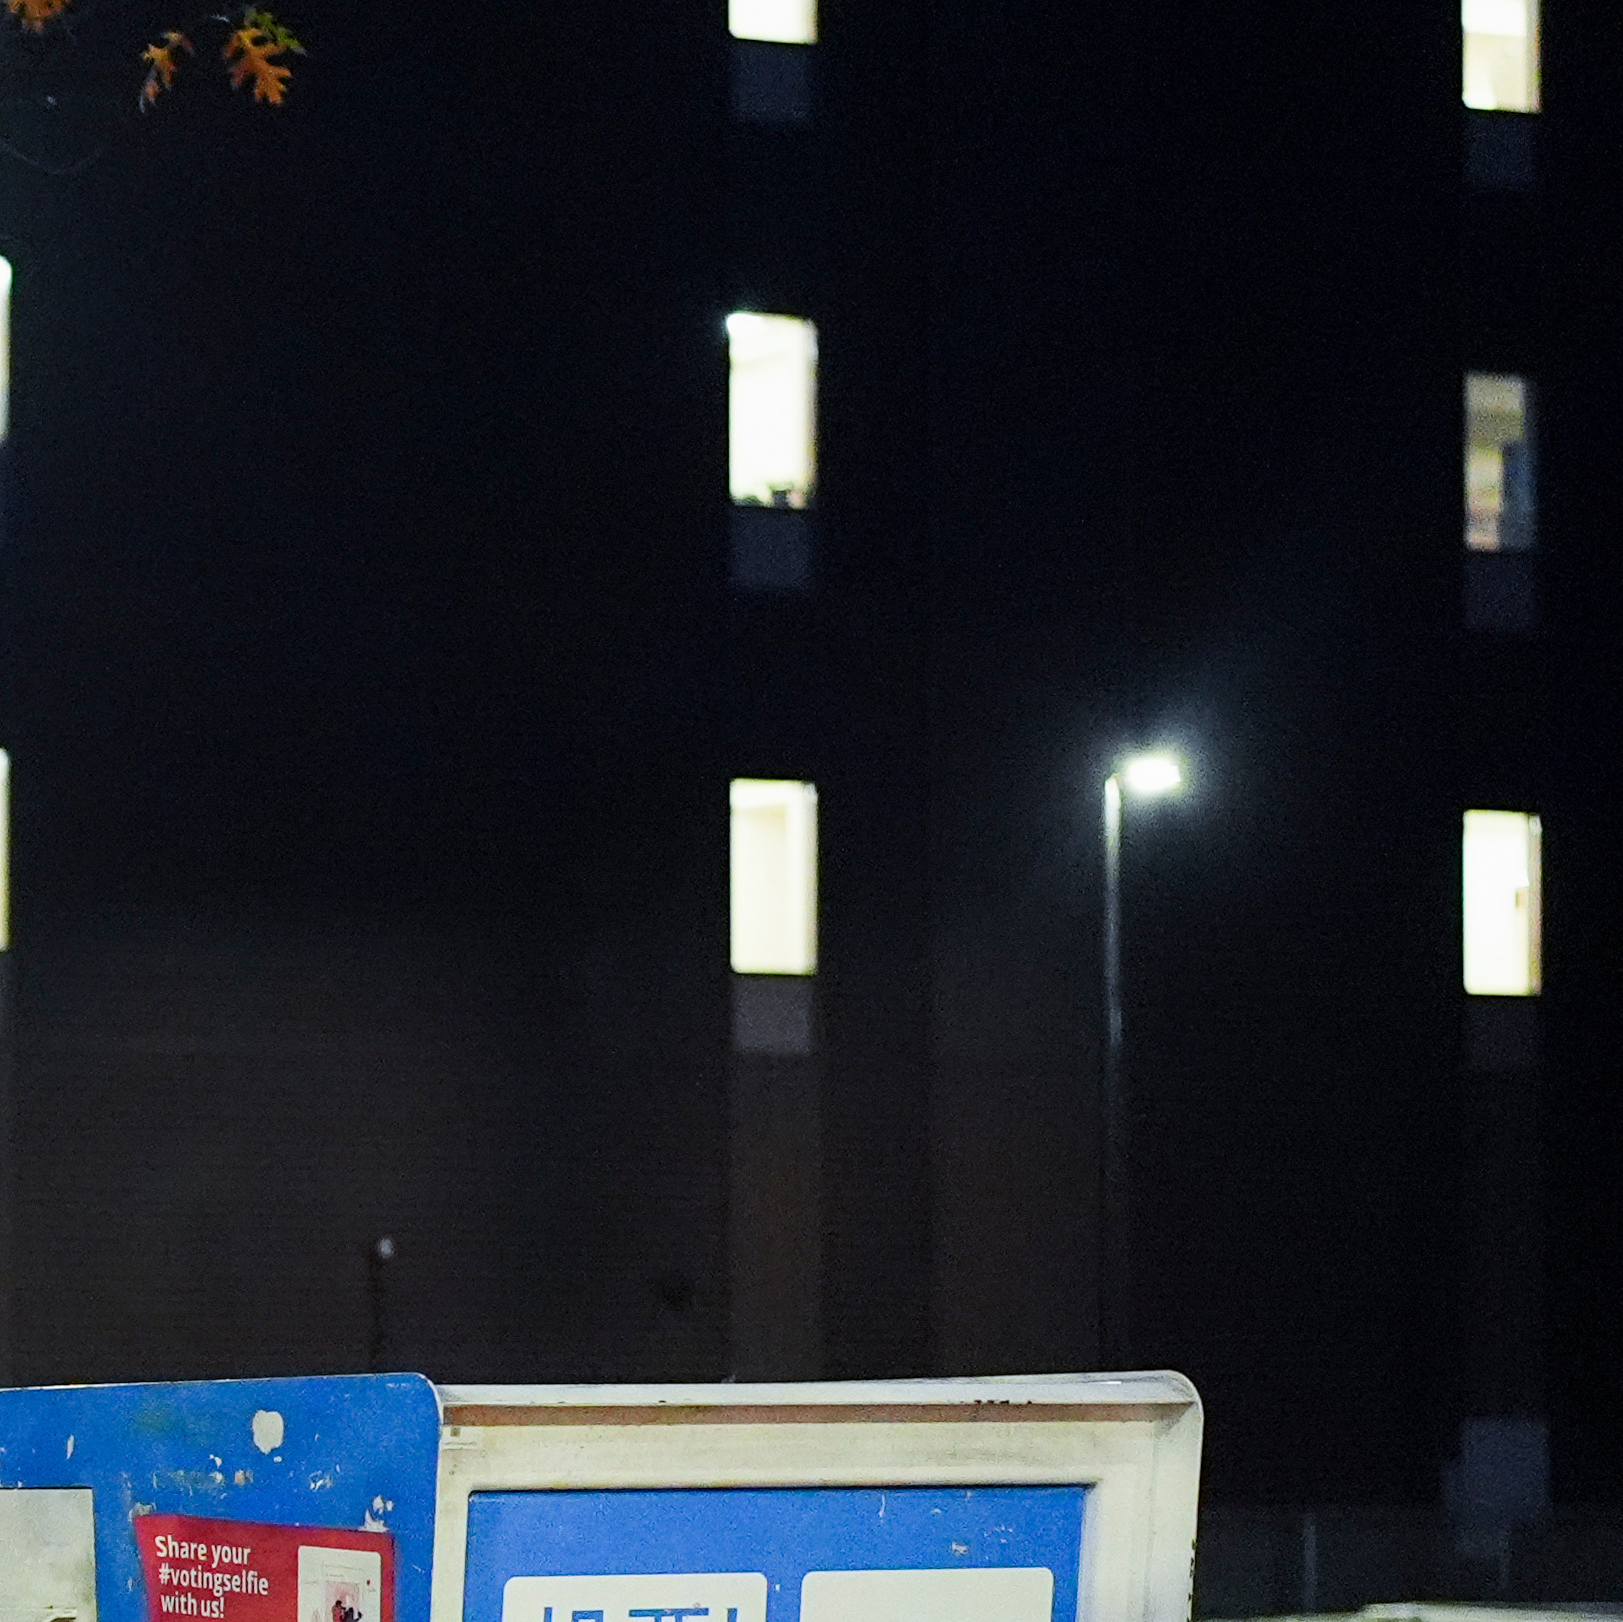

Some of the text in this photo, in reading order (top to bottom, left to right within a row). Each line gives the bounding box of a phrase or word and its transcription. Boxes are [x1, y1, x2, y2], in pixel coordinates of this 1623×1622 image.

[154, 1534, 251, 1569] Share your
[158, 1562, 269, 1597] #votingselfie
[160, 1591, 225, 1619] with us!
